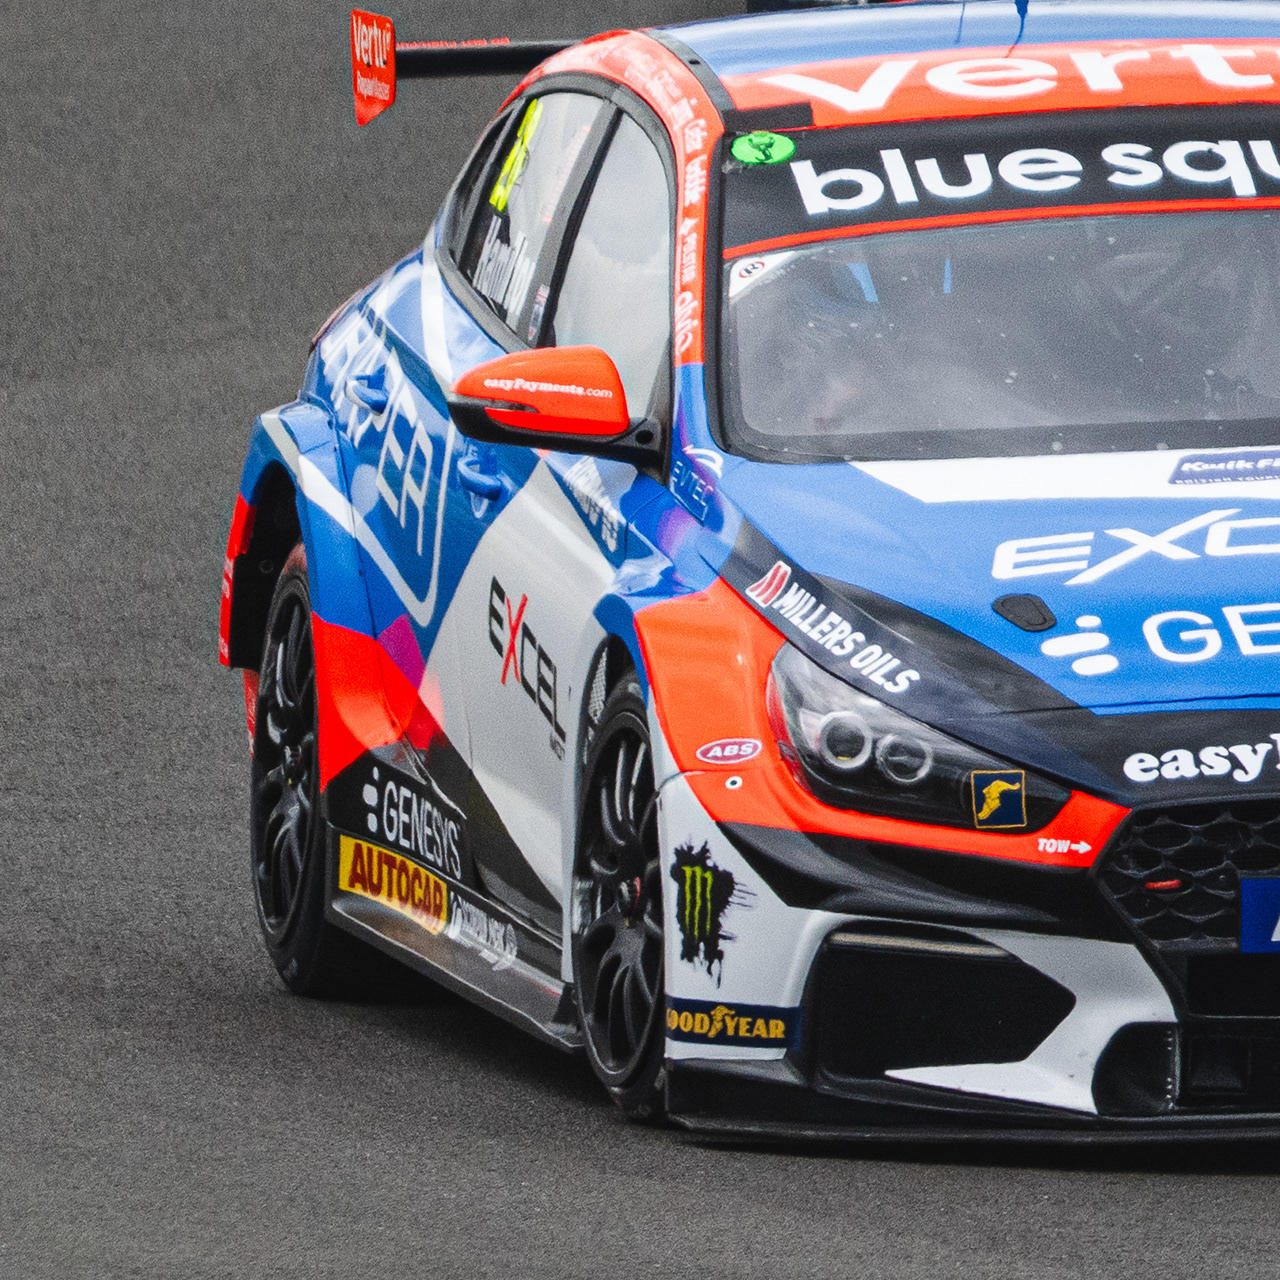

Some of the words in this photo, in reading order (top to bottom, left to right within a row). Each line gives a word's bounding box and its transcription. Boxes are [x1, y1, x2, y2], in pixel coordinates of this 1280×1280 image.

[789, 146, 1084, 215] blue
[484, 378, 613, 398] easyPayments.com
[772, 581, 867, 656] MILLERS
[850, 643, 921, 693] OILS
[706, 743, 754, 759] ABS
[382, 780, 462, 880] GENESYS
[1038, 838, 1071, 853] TOW
[348, 841, 444, 919] AUTOCAR
